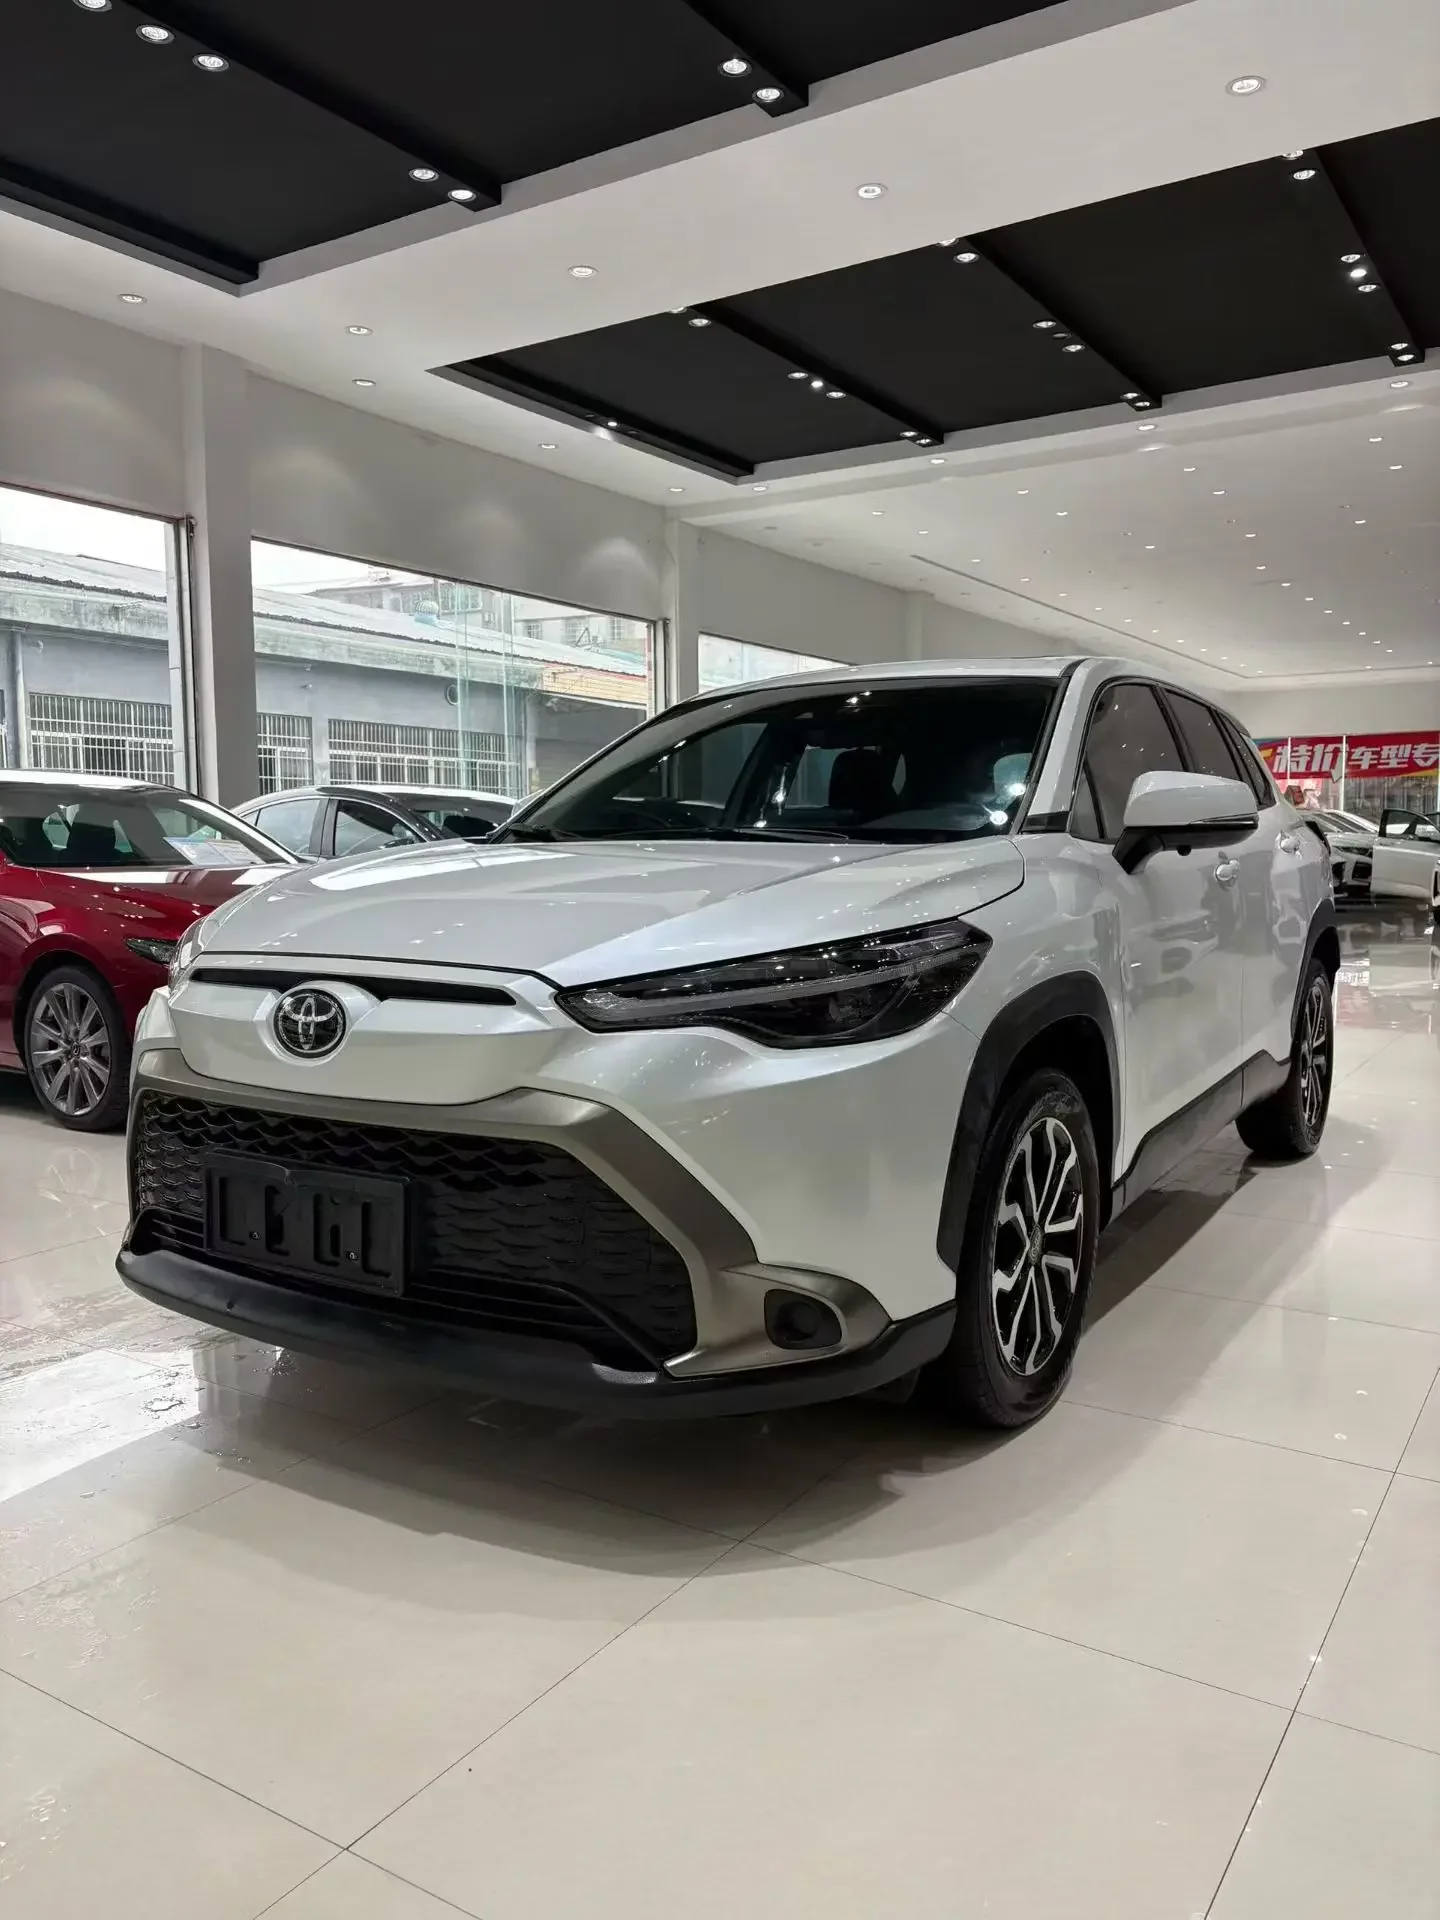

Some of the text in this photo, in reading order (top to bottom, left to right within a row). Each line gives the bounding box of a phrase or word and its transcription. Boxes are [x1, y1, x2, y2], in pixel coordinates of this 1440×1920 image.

[1272, 743, 1440, 783] 特价车型专
